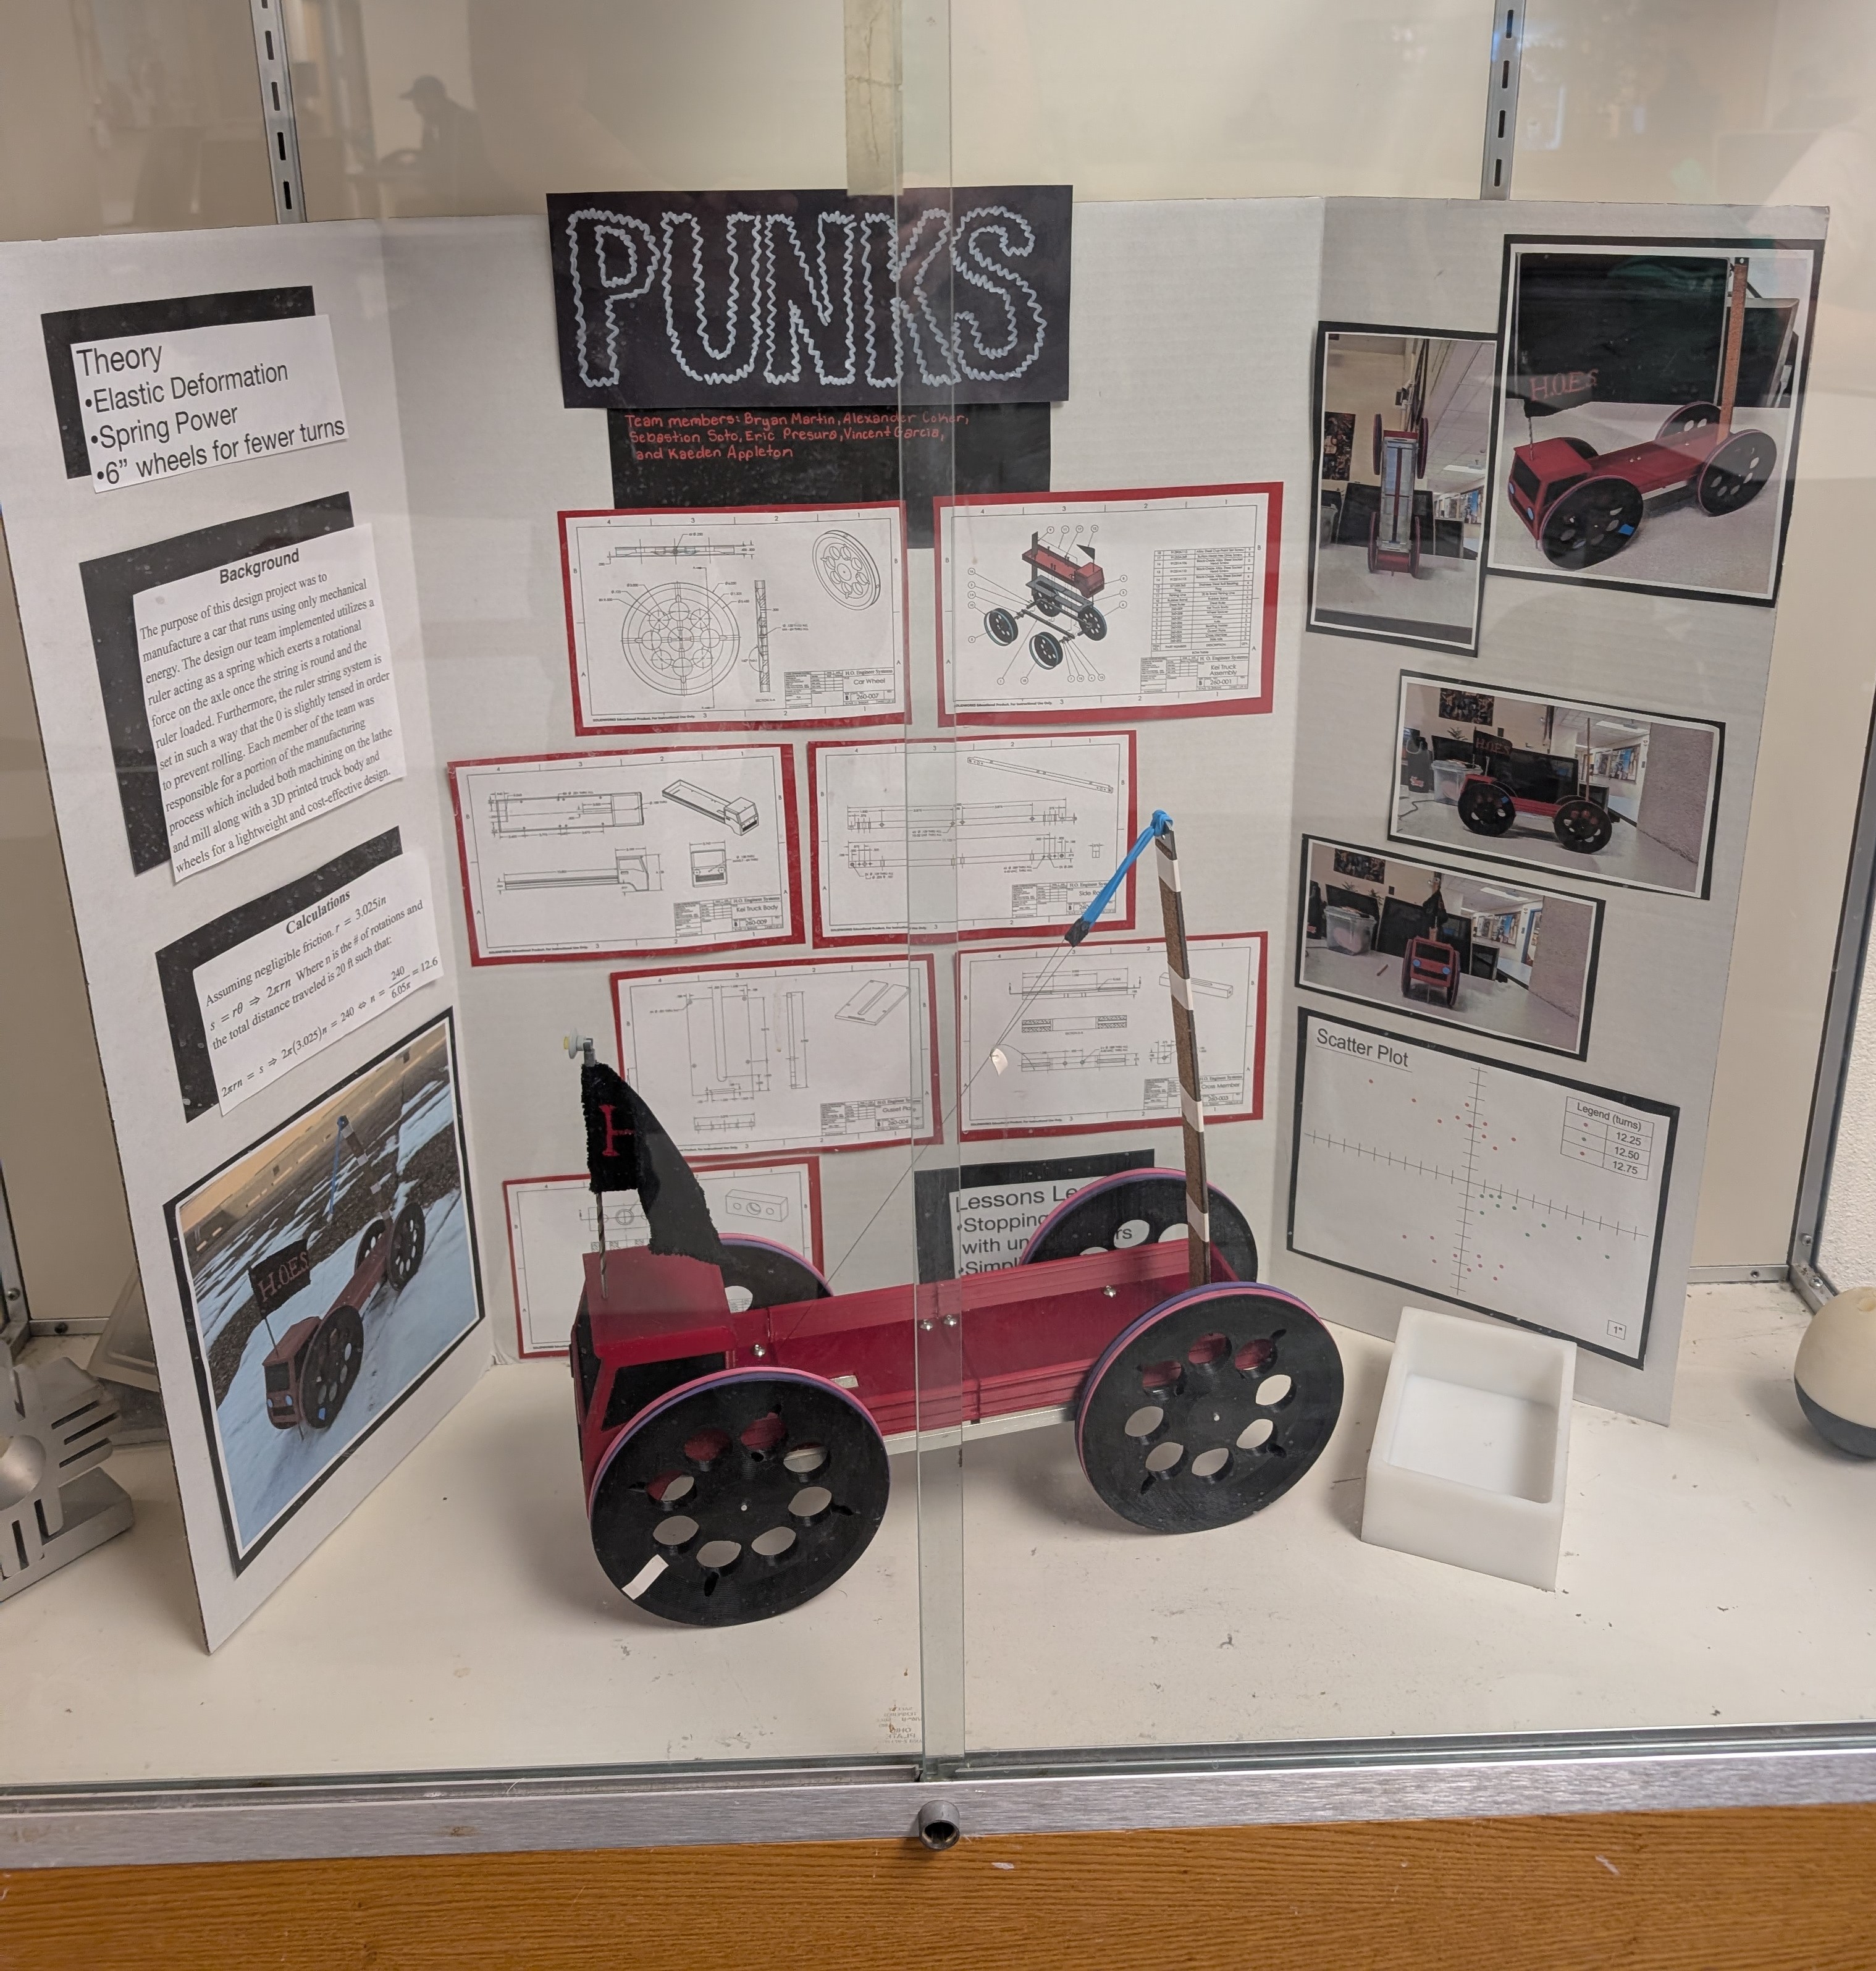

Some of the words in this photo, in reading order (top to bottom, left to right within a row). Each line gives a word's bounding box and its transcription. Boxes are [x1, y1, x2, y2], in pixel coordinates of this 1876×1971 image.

[566, 206, 1047, 387] PUNKS
[76, 345, 162, 376] Theory
[93, 381, 165, 413] Elastic
[170, 363, 288, 400] Deformation
[99, 419, 170, 452] Spring
[175, 407, 238, 434] Power
[625, 415, 663, 428] Team
[668, 413, 741, 428] members:
[744, 412, 788, 431] Bryan
[791, 413, 841, 426] Martin,
[843, 412, 917, 424] Alexander
[746, 431, 775, 441] Eric
[844, 426, 891, 440] Vincent
[894, 426, 944, 441] Garcia,
[135, 444, 208, 478] wheels
[212, 439, 239, 462] for
[243, 429, 295, 455] fewer
[299, 420, 345, 443] turns
[636, 447, 663, 460] and
[668, 448, 721, 460] Kaeden
[727, 445, 793, 461] Appleton
[219, 547, 300, 585] Background
[140, 625, 158, 640] The
[160, 613, 198, 637] purpose
[200, 604, 212, 619] of
[212, 600, 231, 615] this
[233, 593, 264, 609] design
[264, 581, 298, 602] project
[298, 576, 317, 588] was
[318, 573, 327, 583] to
[143, 634, 202, 662] manufacture
[204, 631, 211, 641] a
[212, 625, 227, 638] car
[229, 617, 248, 632] that
[248, 612, 270, 626] runs
[271, 604, 297, 618] using
[298, 595, 318, 610] only
[319, 578, 367, 604] mechanical
[146, 664, 180, 684] energy.
[180, 656, 201, 670] The
[203, 645, 235, 663] design
[237, 639, 253, 651] our
[254, 631, 277, 646] team
[278, 608, 335, 638] implemented
[337, 601, 368, 618] utilizes
[369, 599, 375, 607] a
[169, 809, 204, 837] process
[206, 794, 235, 815] which
[236, 774, 276, 802] included
[276, 766, 297, 783] both
[298, 749, 344, 774] machining
[345, 743, 356, 754] on
[356, 737, 371, 749] the
[371, 728, 393, 743] lathe
[176, 850, 210, 873] wheels
[211, 843, 226, 858] for
[228, 840, 235, 850] a
[235, 814, 288, 846] lightweight
[289, 804, 306, 821] and
[307, 781, 363, 812] cost-effective
[364, 769, 391, 786] design.
[285, 890, 350, 934] Calculations
[295, 960, 324, 981] Where
[332, 949, 340, 960] is
[340, 941, 352, 955] the
[360, 927, 370, 941] of
[370, 910, 405, 935] rotations
[406, 899, 424, 916] and
[206, 974, 253, 1007] Assuming
[254, 948, 301, 979] negligible
[212, 1036, 227, 1050] the
[229, 1018, 250, 1040] total
[252, 1000, 290, 1026] distance
[292, 975, 327, 1004] traveled
[327, 972, 335, 983] is
[347, 957, 354, 969] ft
[355, 946, 373, 964] such
[1317, 1028, 1373, 1056] Scatter
[1377, 1044, 1408, 1067] Plot
[1577, 1102, 1610, 1120] Legend
[1612, 1115, 1641, 1132] (turns)
[1617, 1132, 1641, 1146] 12.25
[1613, 1161, 1638, 1175] 12.75
[1615, 1147, 1639, 1160] 12.50
[956, 1191, 1045, 1212] Lessons
[962, 1238, 1000, 1254] with
